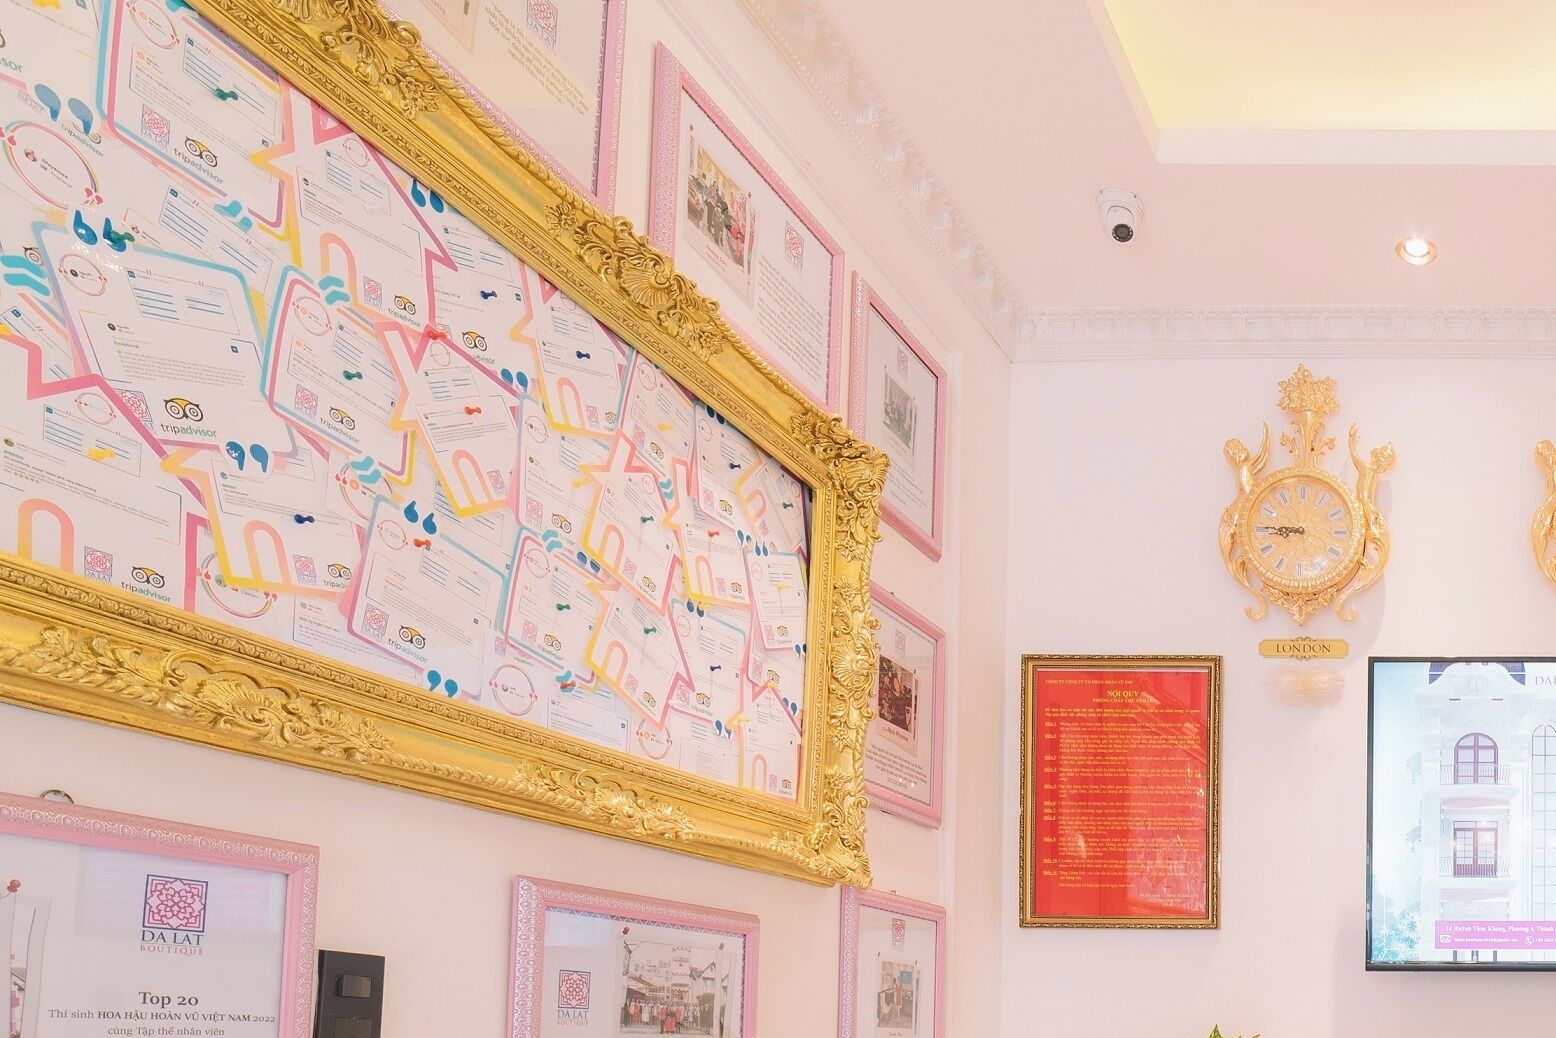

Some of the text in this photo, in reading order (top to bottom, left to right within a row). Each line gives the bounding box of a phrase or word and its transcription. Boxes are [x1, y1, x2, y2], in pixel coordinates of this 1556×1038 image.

[173, 148, 224, 184] tripadvisor
[160, 422, 216, 438] tripadvisor
[320, 417, 359, 444] tripadvisor
[121, 581, 171, 602] tripadvisor
[388, 638, 428, 664] tripadvisor
[1276, 644, 1330, 652] LONDON
[140, 929, 204, 946] DA LAT
[140, 944, 204, 956] BOUTIQUE
[138, 991, 199, 1008] Top 20
[48, 1009, 68, 1019] Thí
[71, 1009, 95, 1020] sinh
[98, 1011, 122, 1020] HOA
[124, 1009, 148, 1023] HẬU
[150, 1010, 182, 1021] HOÀN
[184, 1010, 200, 1021] VŨ
[201, 1010, 226, 1023] VIỆT
[228, 1014, 251, 1022] NAM
[557, 1010, 588, 1019] DA LAT
[108, 1024, 225, 1038] cùng Tập thể nhân viên
